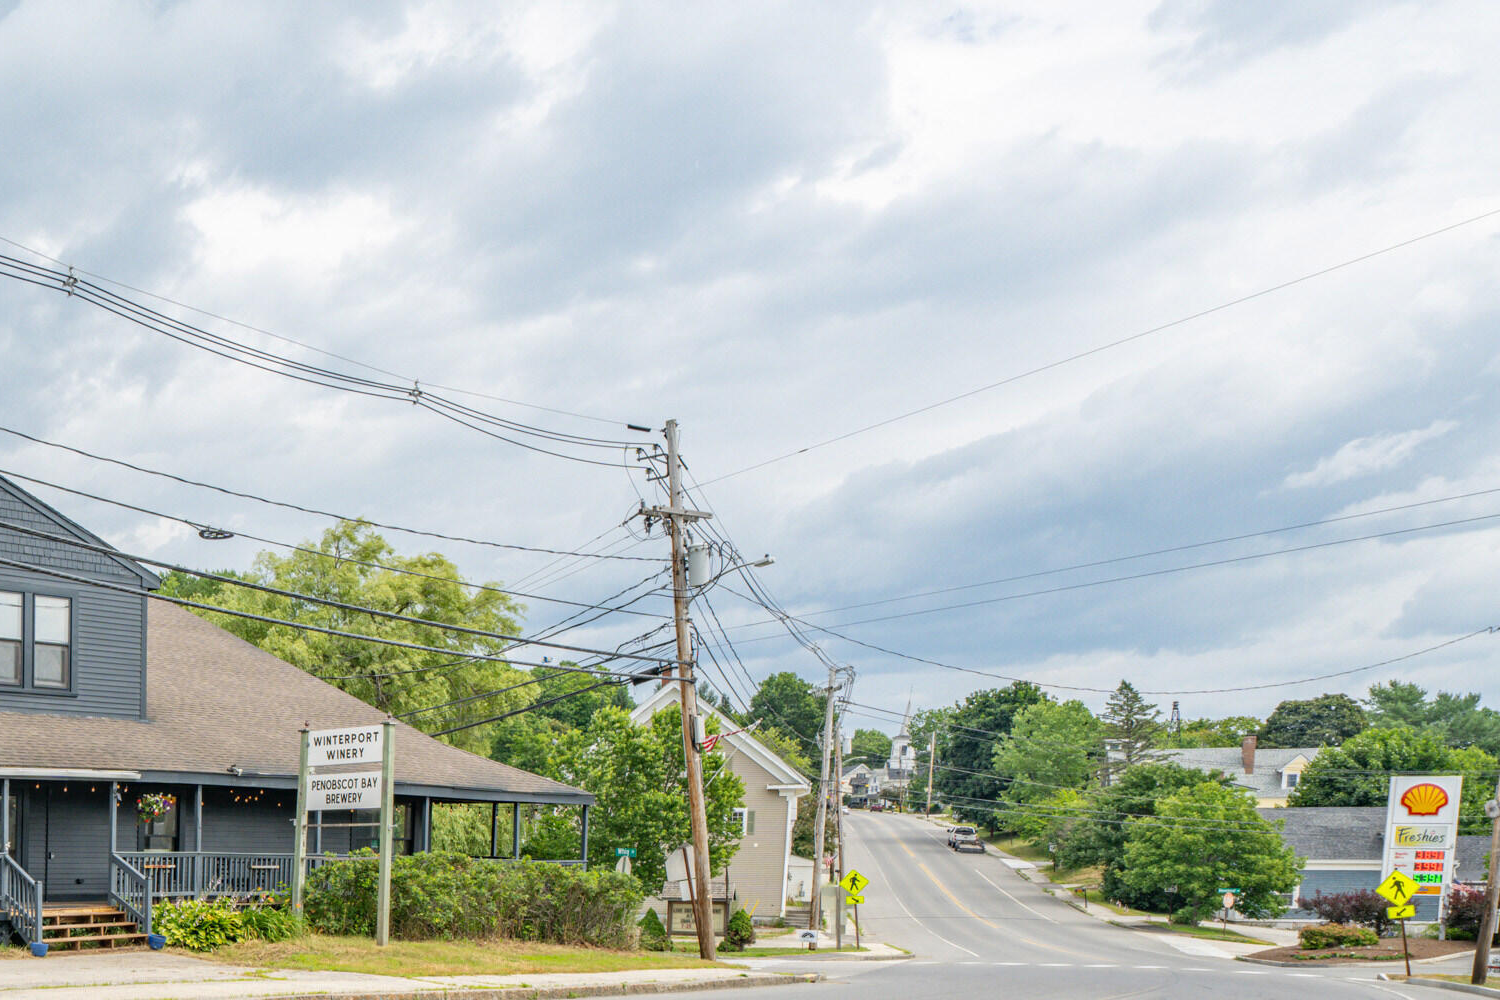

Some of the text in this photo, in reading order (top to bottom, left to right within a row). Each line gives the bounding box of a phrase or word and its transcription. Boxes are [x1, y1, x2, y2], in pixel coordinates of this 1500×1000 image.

[313, 731, 379, 747] WINTERPORT
[326, 747, 364, 760] WINERY
[311, 777, 378, 791] PENOBSCOT BAY
[325, 792, 363, 804] BREWERY
[1397, 827, 1445, 843] Freshies
